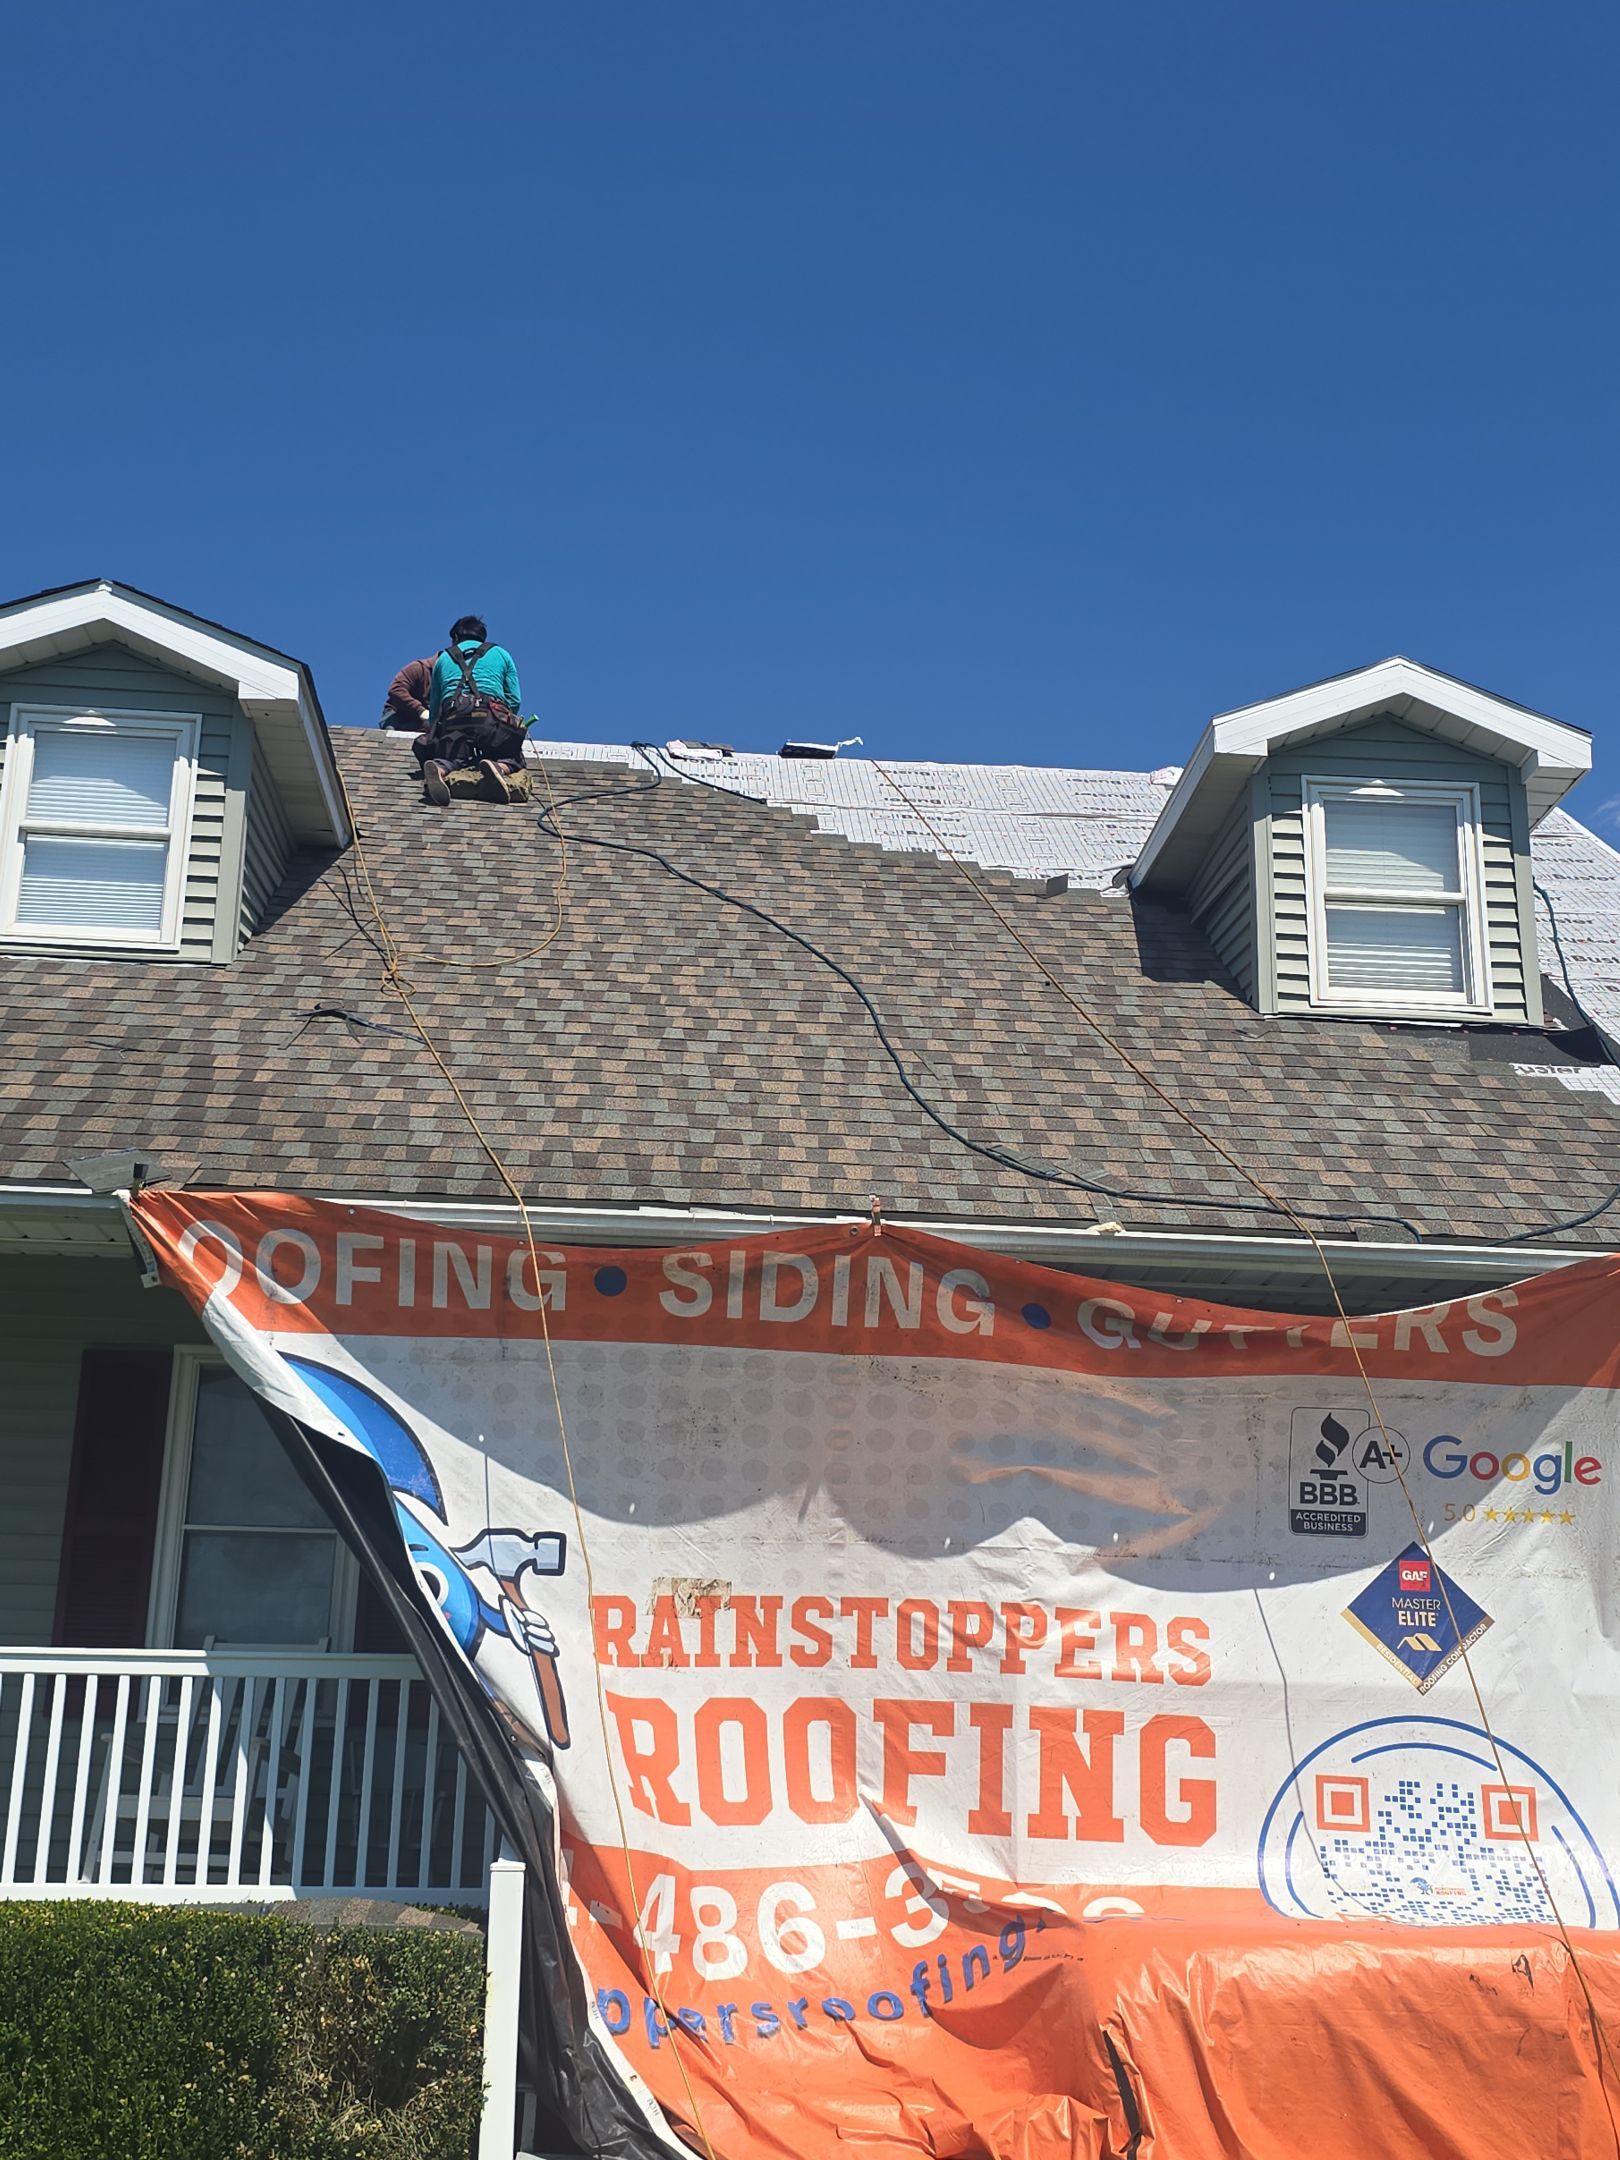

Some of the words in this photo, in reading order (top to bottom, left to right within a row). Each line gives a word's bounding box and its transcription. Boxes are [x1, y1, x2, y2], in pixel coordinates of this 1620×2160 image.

[658, 1249, 997, 1337] SIDING
[1076, 1288, 1520, 1358] GUTERS
[1359, 1440, 1403, 1469] A+
[1422, 1434, 1603, 1496] Google
[1295, 1511, 1361, 1523] ACCREDITED
[1443, 1503, 1476, 1522] 5.0
[1303, 1520, 1354, 1532] BUSINESS
[1401, 1569, 1428, 1582] GAF
[1391, 1596, 1441, 1611] MASTER
[1397, 1610, 1437, 1628] ELITE
[592, 1594, 1212, 1687] RAINSTOPPERS
[1418, 1664, 1449, 1695] ROOFING
[606, 1689, 1217, 1847] ROOFING
